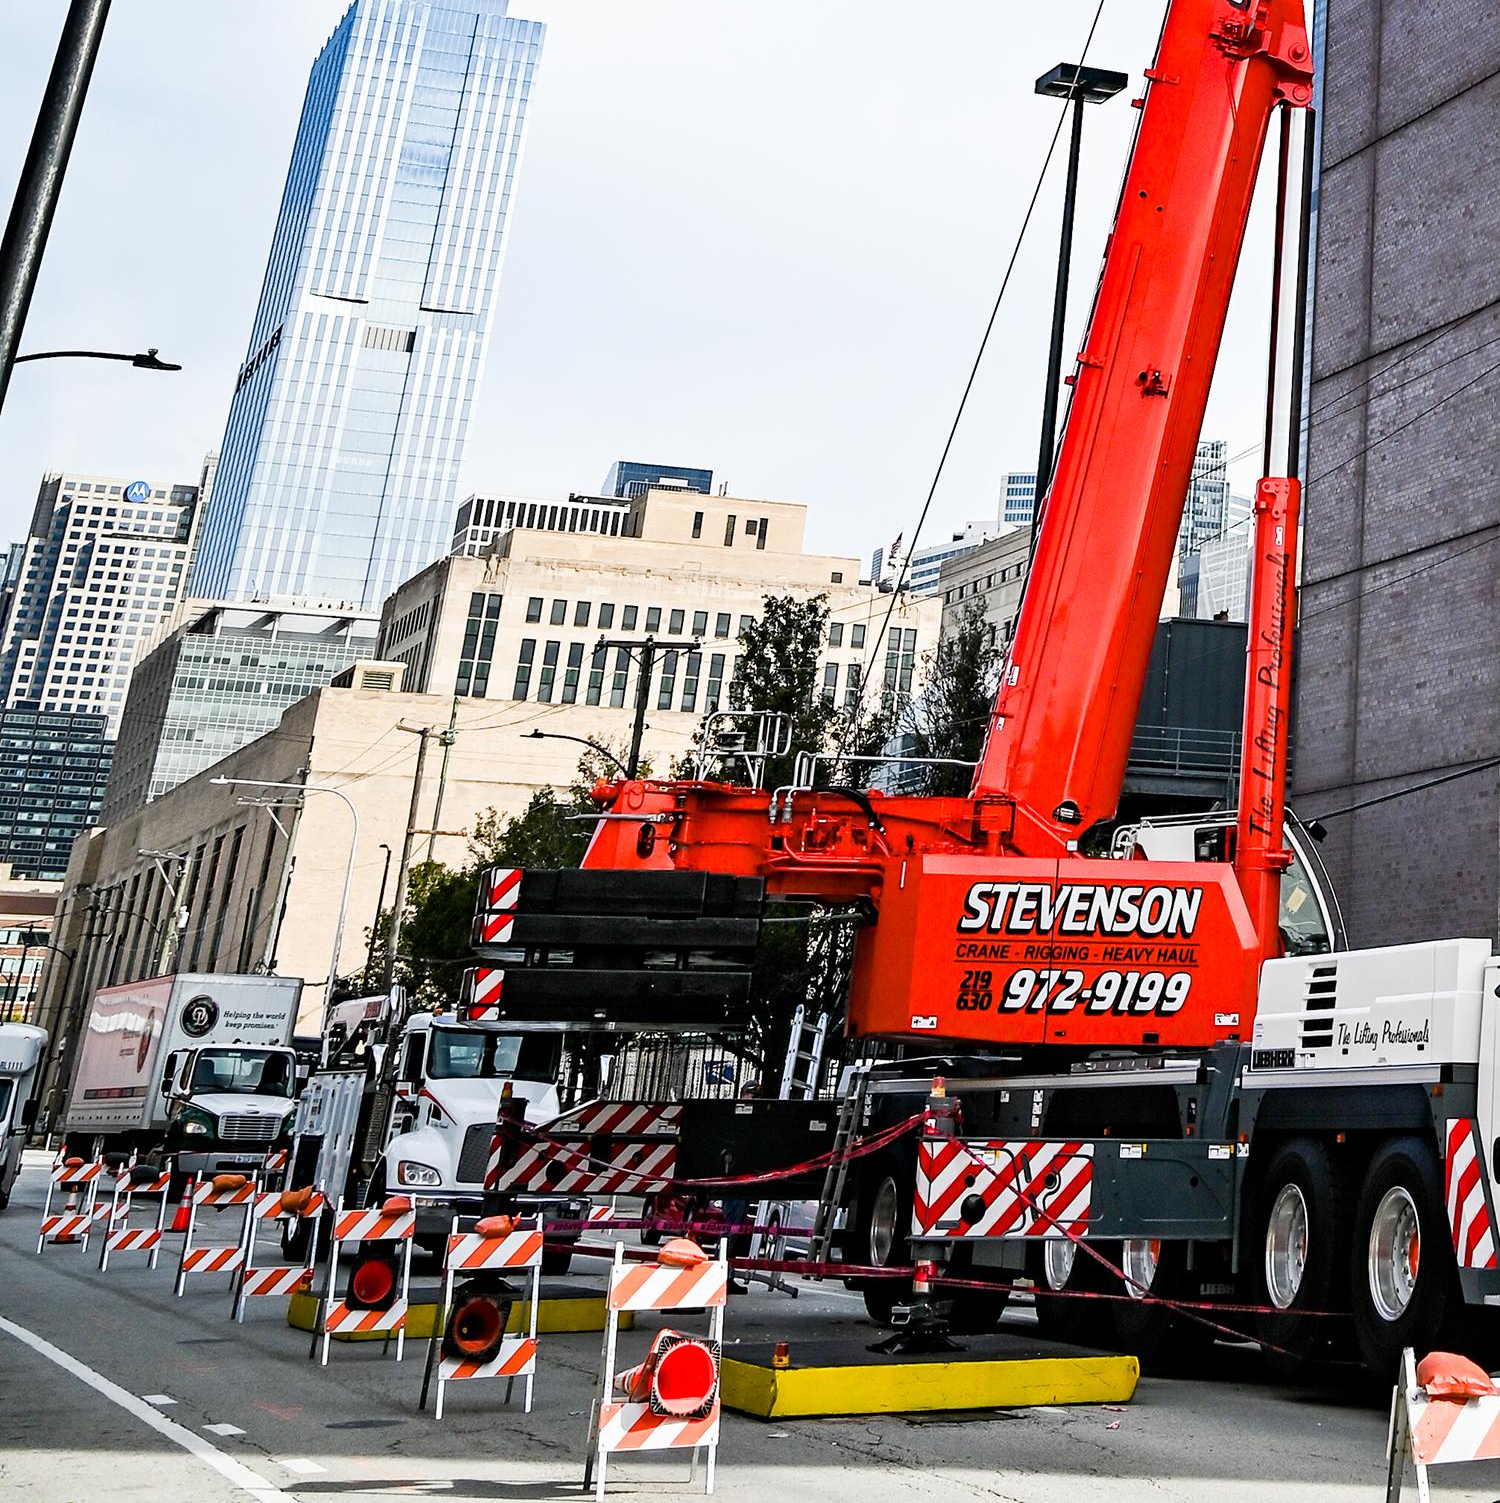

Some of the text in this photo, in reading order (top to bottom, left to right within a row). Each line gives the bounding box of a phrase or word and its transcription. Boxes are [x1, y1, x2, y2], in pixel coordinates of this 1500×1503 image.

[1249, 551, 1290, 837] The Lifting Professionals
[957, 881, 1203, 938] STEVENSON
[955, 943, 1010, 960] CRANE
[1024, 945, 1090, 961] RIGGING
[1101, 946, 1153, 962] HEAVY
[1156, 947, 1198, 963] HAUL
[959, 970, 993, 990] 219
[956, 992, 993, 1011] 630
[997, 968, 1193, 1015] 972-9199
[223, 1010, 287, 1020] Helping the world
[225, 1021, 242, 1029] keep
[1338, 1019, 1430, 1051] The Lifting Professionals
[1253, 1048, 1296, 1070] LIEBHERR
